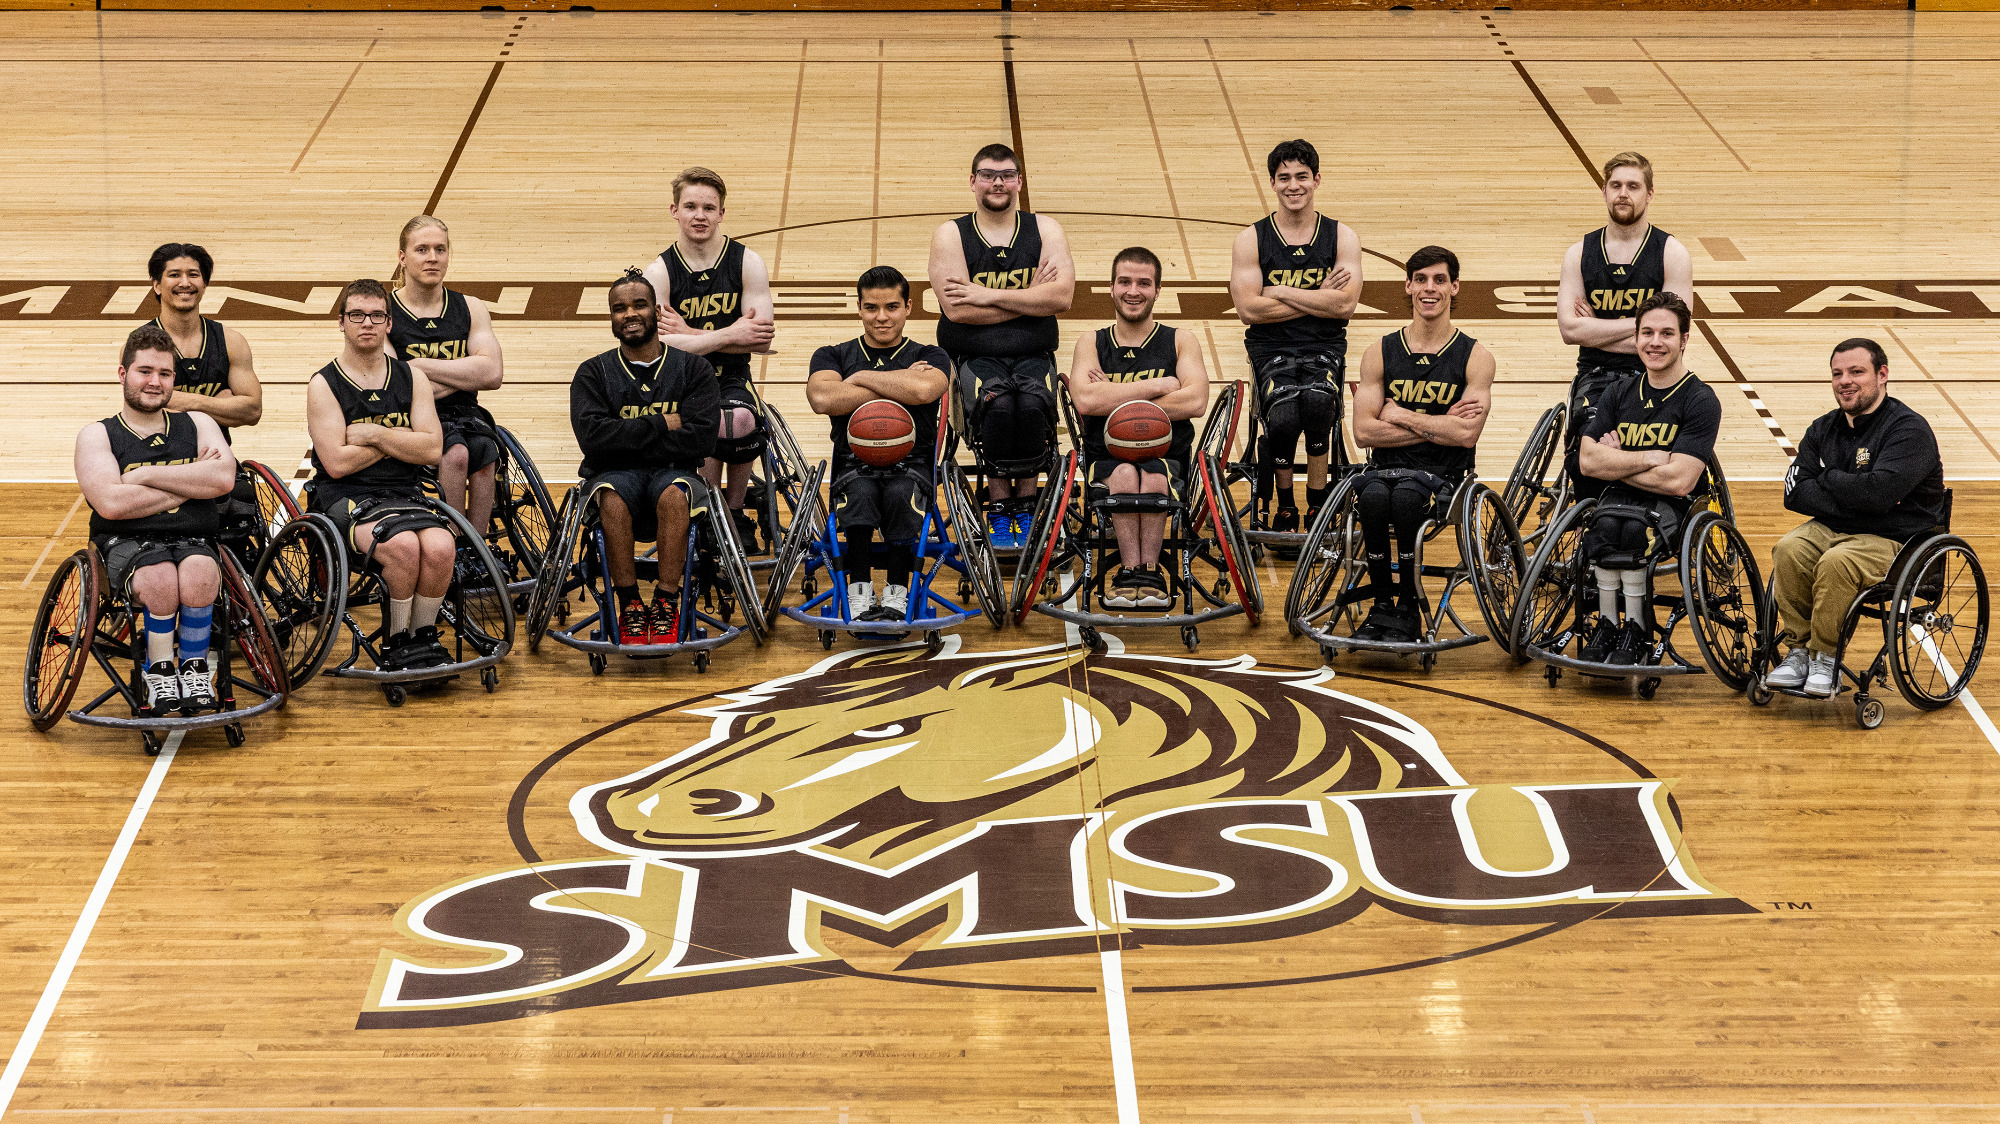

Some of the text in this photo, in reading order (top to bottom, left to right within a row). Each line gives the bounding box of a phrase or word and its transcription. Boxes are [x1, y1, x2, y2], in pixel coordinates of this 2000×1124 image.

[973, 267, 1037, 290] SMSU
[1268, 266, 1332, 289] SMSU
[679, 292, 739, 320] SMSU
[1590, 288, 1655, 311] SMSU
[405, 339, 467, 360] SMSU
[1105, 368, 1166, 383] MSU
[1388, 379, 1458, 405] SMSU
[351, 412, 410, 428] SU
[1616, 422, 1679, 447] SMSU
[1558, 631, 1573, 647] END
[1652, 613, 1676, 658] TOP END
[360, 779, 1735, 1018] SMSU
[1766, 901, 1813, 910] TM
